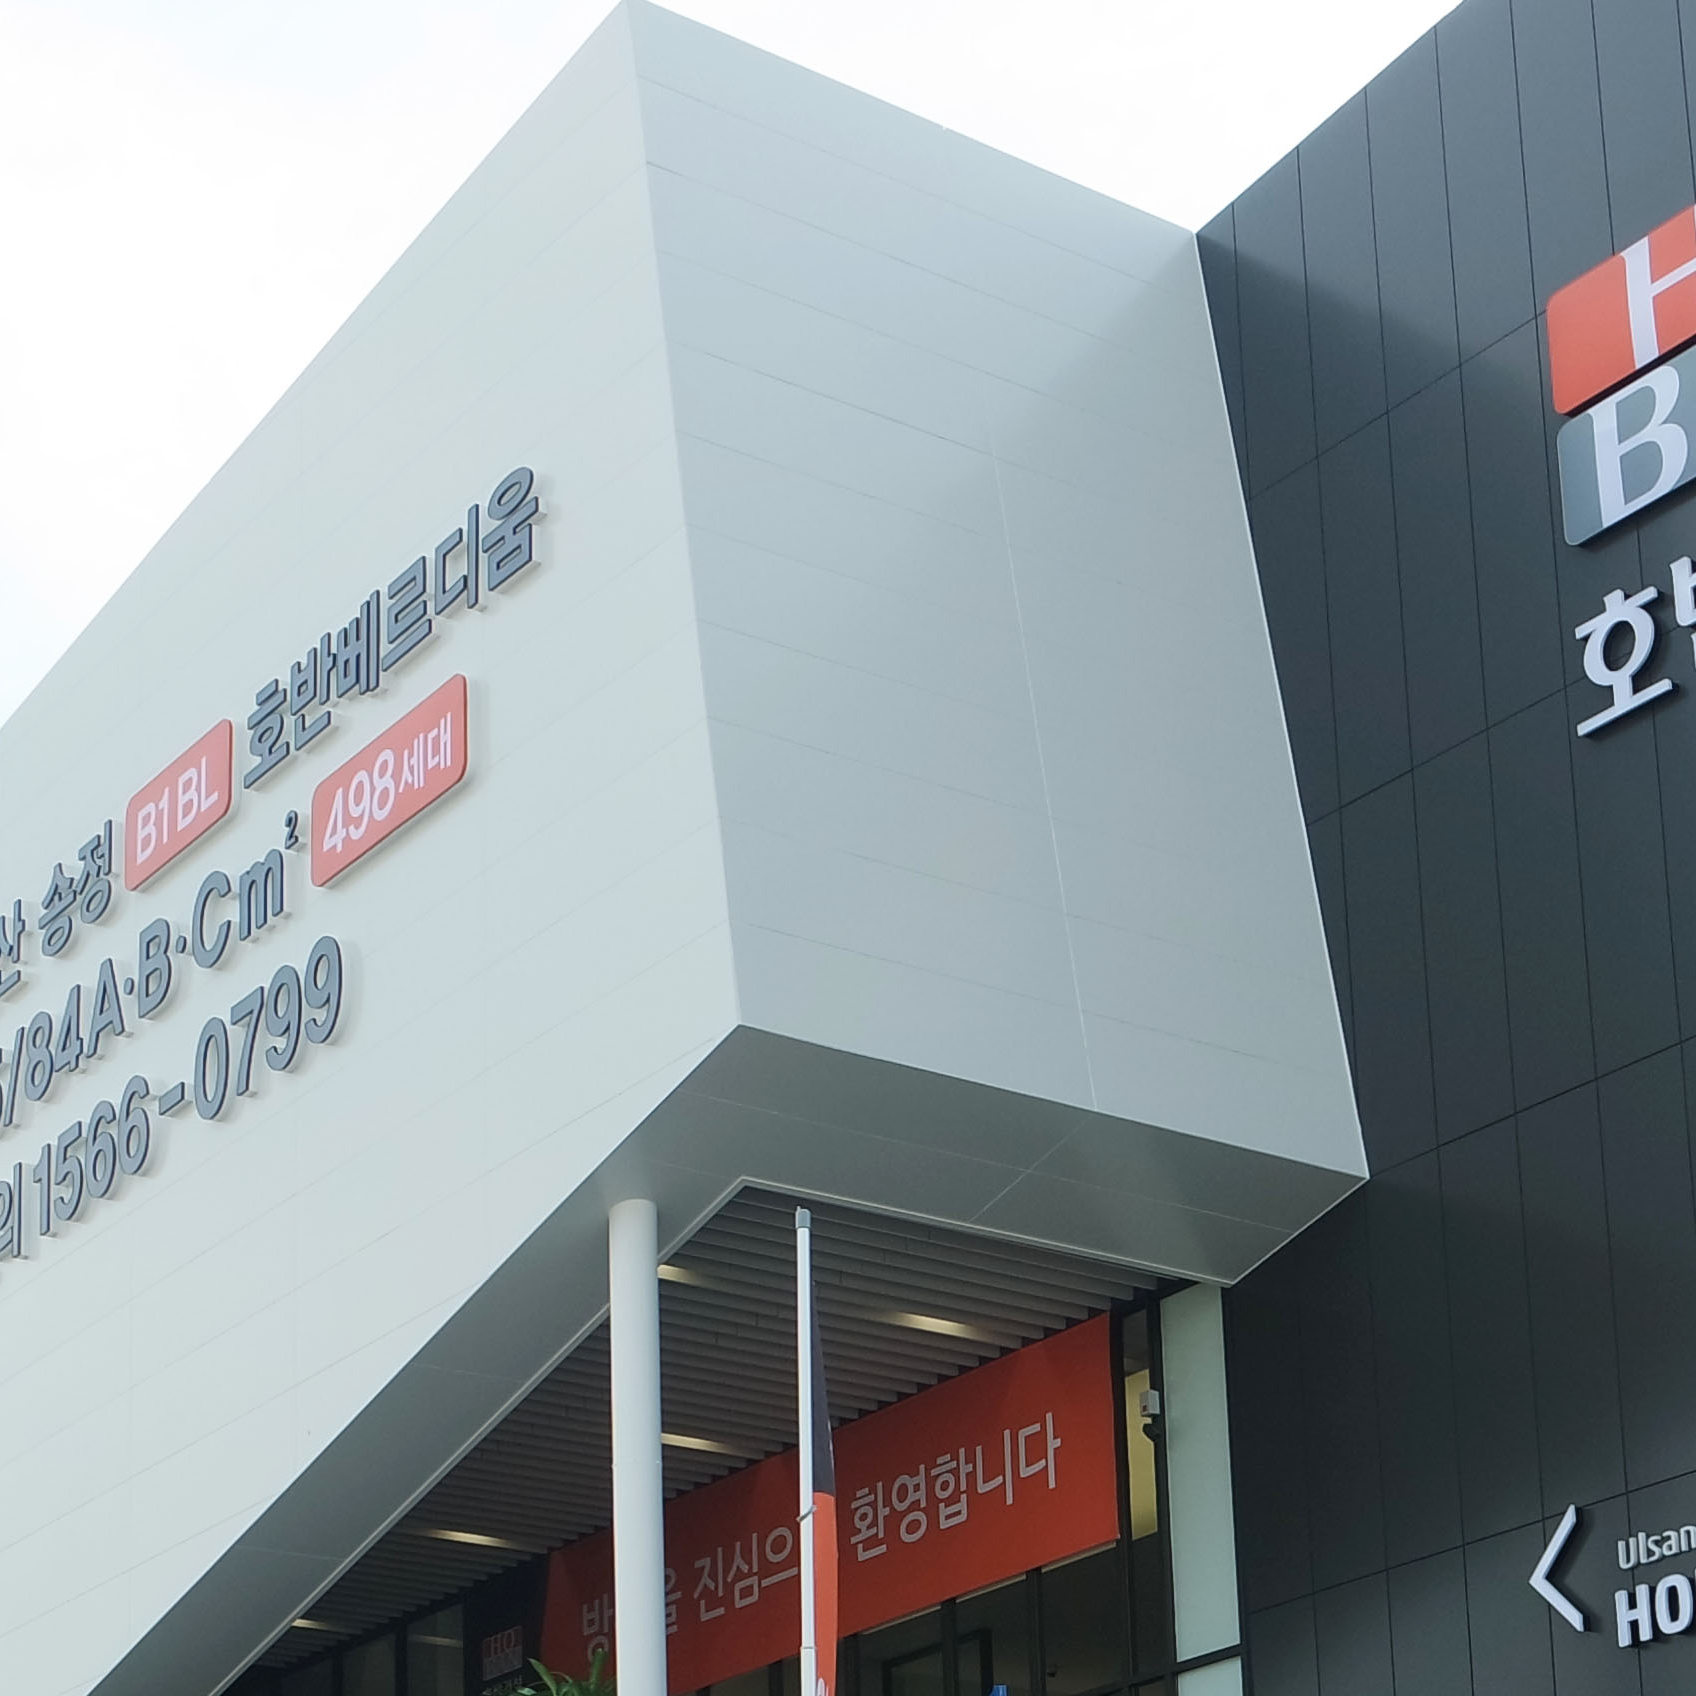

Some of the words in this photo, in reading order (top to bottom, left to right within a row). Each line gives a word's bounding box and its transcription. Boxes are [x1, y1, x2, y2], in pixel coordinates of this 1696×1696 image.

[38, 819, 114, 957] 송정
[243, 466, 543, 789] 호반베르디움
[32, 935, 344, 1237] 1566-0799
[694, 1524, 800, 1622] 진심으
[849, 1411, 1062, 1563] 환영합니다
